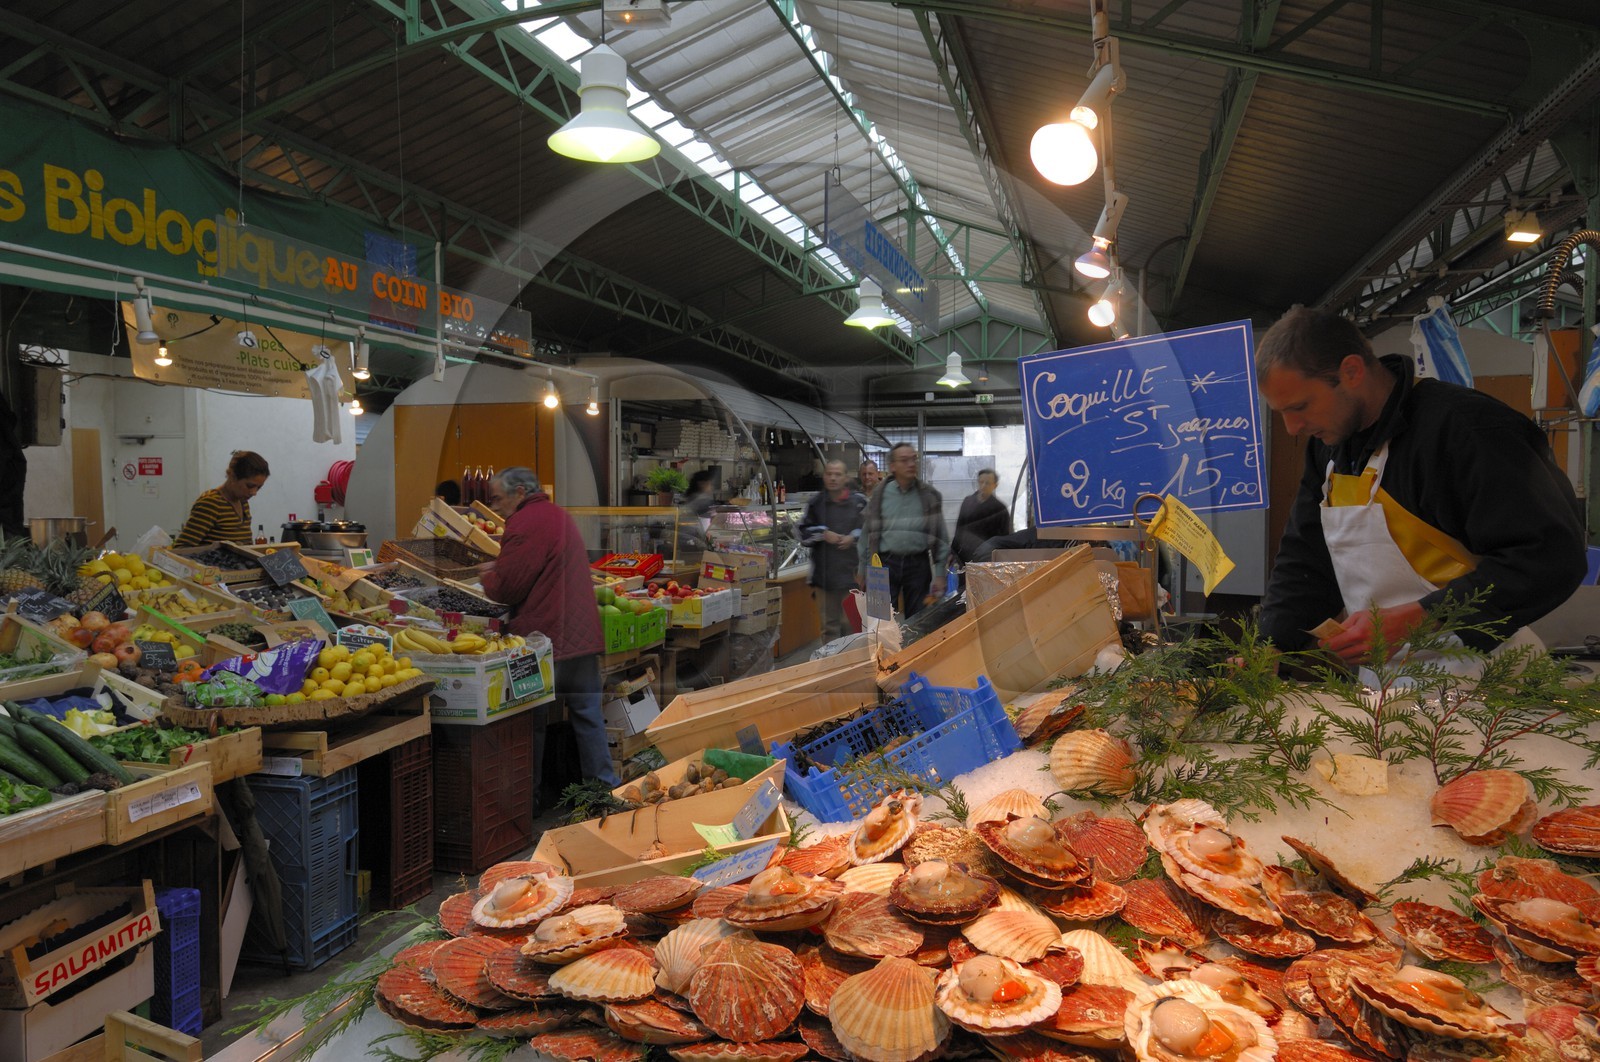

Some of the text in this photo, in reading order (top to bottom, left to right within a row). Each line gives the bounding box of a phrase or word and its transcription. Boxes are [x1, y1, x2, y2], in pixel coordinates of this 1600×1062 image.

[324, 257, 474, 322] AU COIN BIO
[34, 914, 152, 996] SALAMITA
